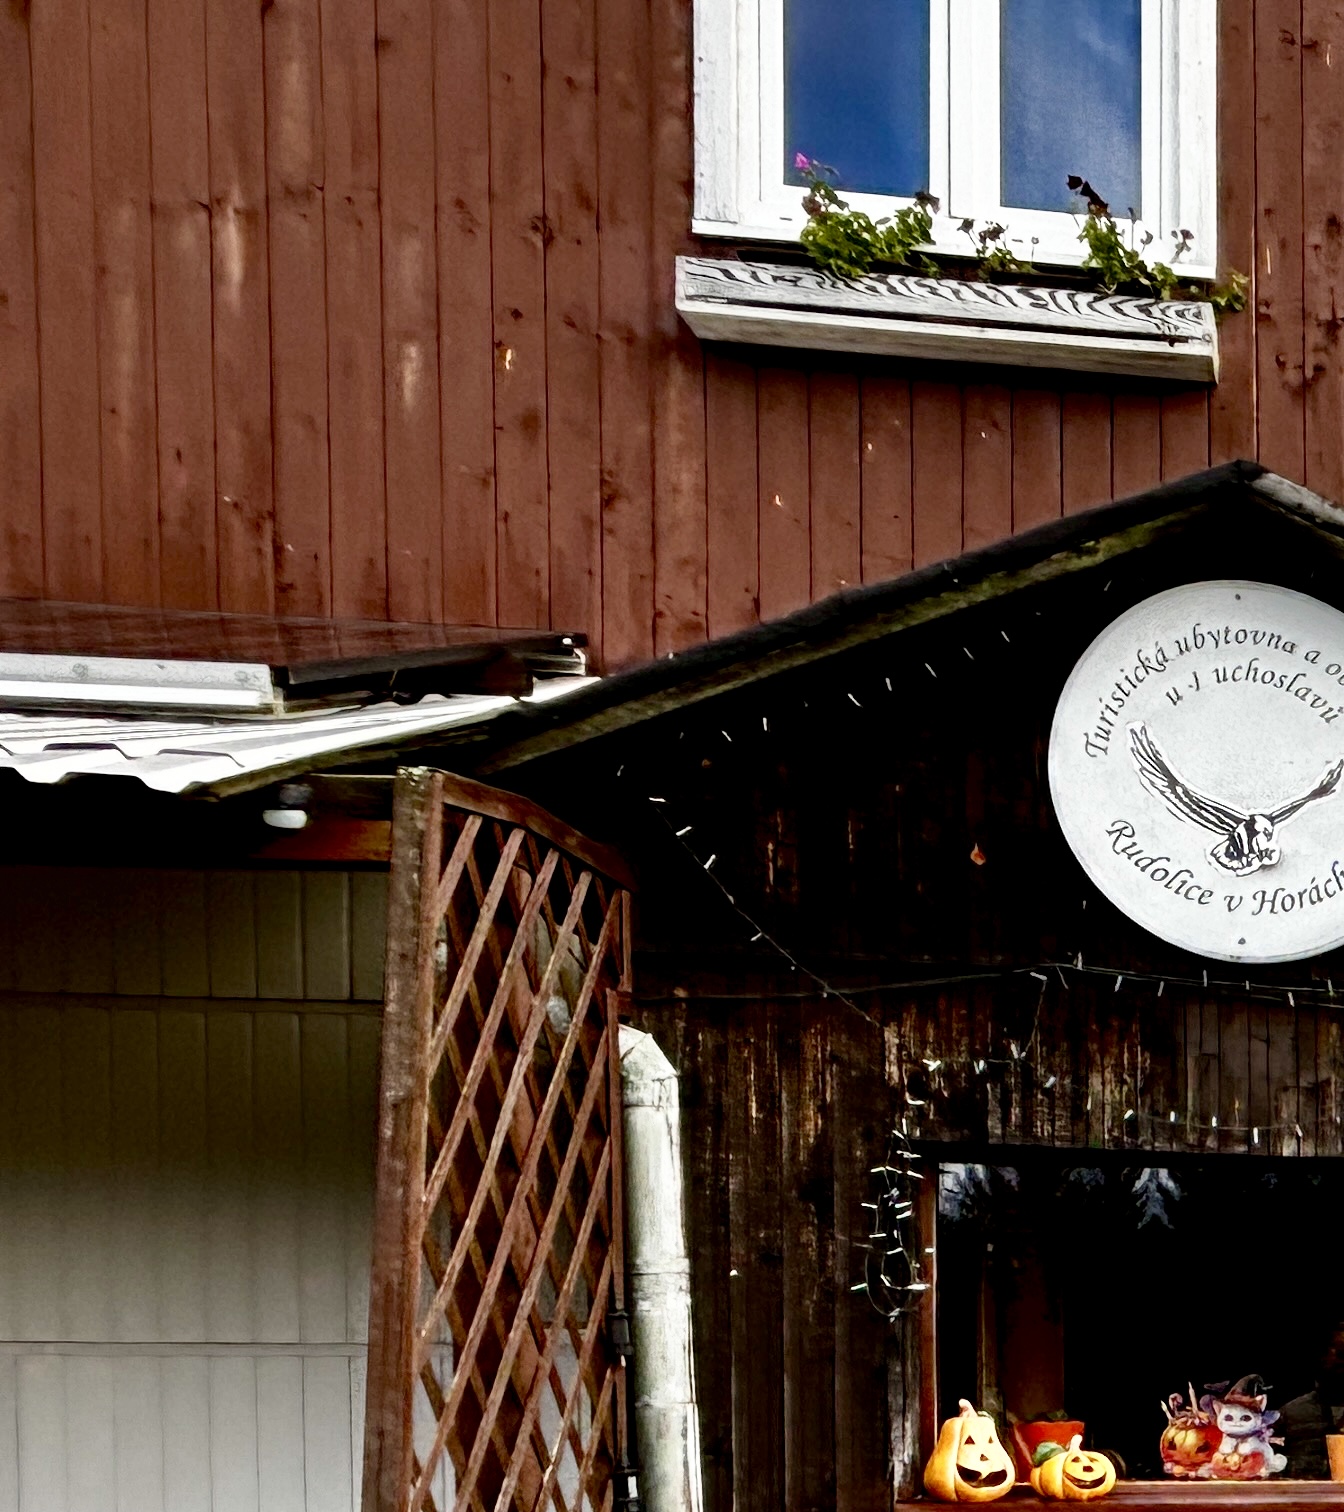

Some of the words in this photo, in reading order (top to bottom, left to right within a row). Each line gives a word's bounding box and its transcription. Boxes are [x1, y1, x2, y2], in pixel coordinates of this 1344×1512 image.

[1083, 641, 1170, 758] Turistická
[1175, 623, 1298, 656] ubytovna
[1303, 649, 1322, 665] a
[1165, 687, 1184, 706] u
[1105, 819, 1214, 905] Rudolice
[1224, 894, 1243, 912] v
